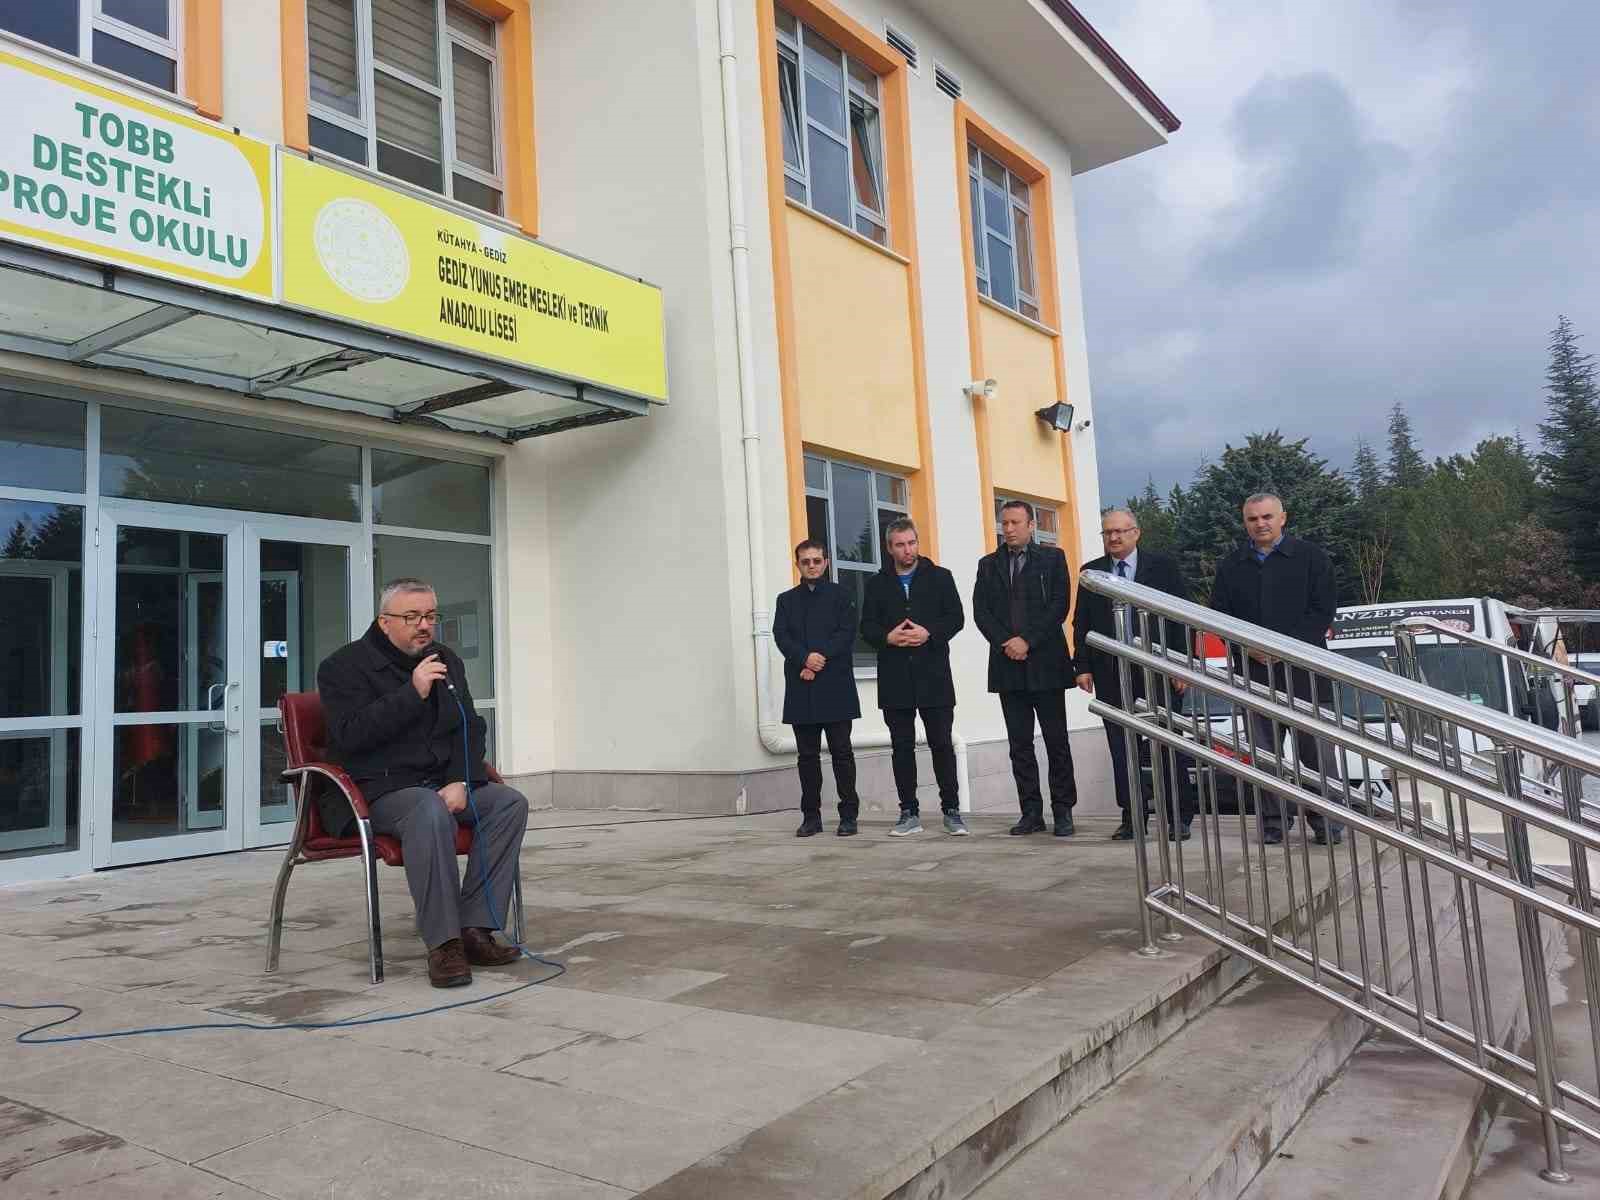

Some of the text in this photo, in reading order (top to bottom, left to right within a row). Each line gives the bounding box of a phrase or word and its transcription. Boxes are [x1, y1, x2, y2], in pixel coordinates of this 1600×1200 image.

[75, 102, 175, 164] TOBB
[129, 208, 248, 268] OKULU
[437, 228, 477, 254] KÜTAHYA
[484, 245, 508, 264] GEDİZ
[438, 255, 609, 333] GEDİZ YUNUS EMRE MESLEKİ ve TEKNİK
[440, 296, 518, 343] ANADOLU LİSESİ
[1334, 609, 1405, 621] NZER
